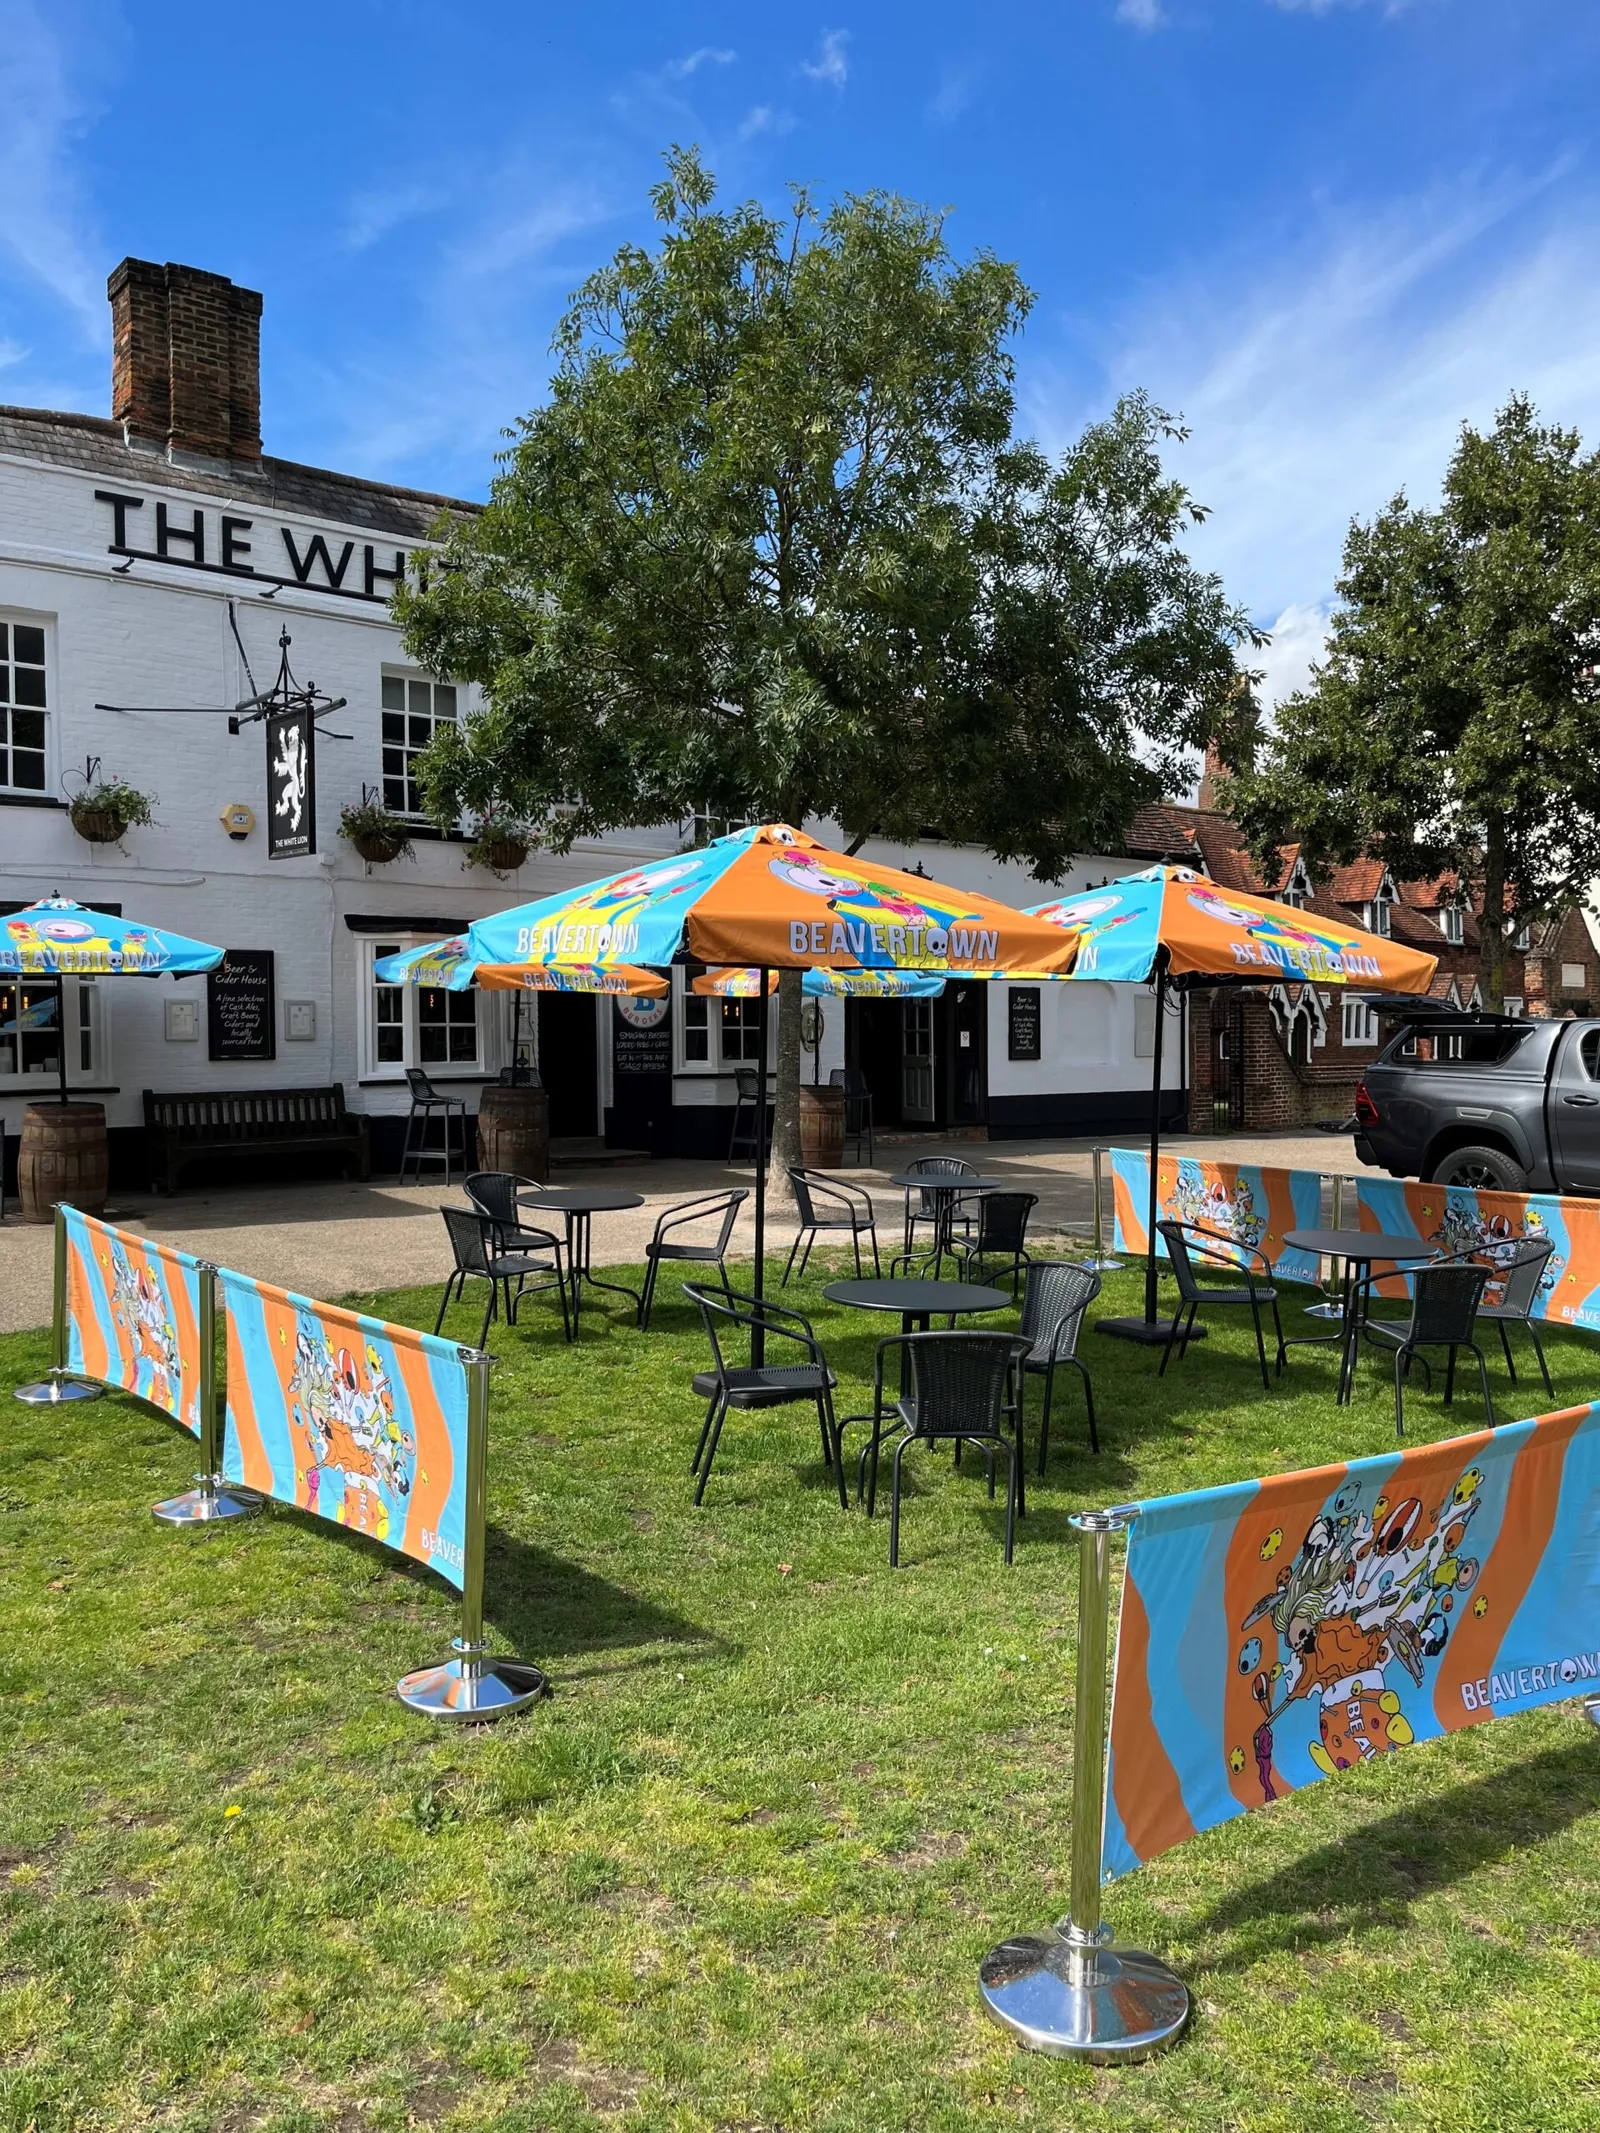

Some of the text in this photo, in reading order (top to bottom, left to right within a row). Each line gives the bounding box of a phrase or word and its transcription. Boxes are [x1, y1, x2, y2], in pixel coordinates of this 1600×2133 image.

[95, 490, 254, 573] THE
[232, 814, 248, 825] ADT
[275, 835, 308, 848] THE WHITE LION
[514, 922, 640, 957] BEAVERTOWN
[789, 921, 999, 961] BEAVERTOWN
[0, 949, 161, 968] BEAVERTOWN
[1229, 943, 1383, 977] BEAVERTOWN
[226, 963, 257, 974] Beer &
[215, 973, 267, 985] Cider House
[523, 972, 629, 994] BEAVERTOWN
[822, 980, 910, 993] BEAVERTOWN
[216, 994, 265, 1004] A fine selection
[220, 1003, 228, 1011] of
[228, 1003, 244, 1011] Cask
[220, 1011, 239, 1020] Craft
[623, 1007, 663, 1025] BURGERS
[224, 1019, 260, 1028] Ciders and
[231, 1028, 252, 1038] locally
[221, 1036, 263, 1046] sourced food
[1460, 1650, 1600, 1712] BEAVERTOW
